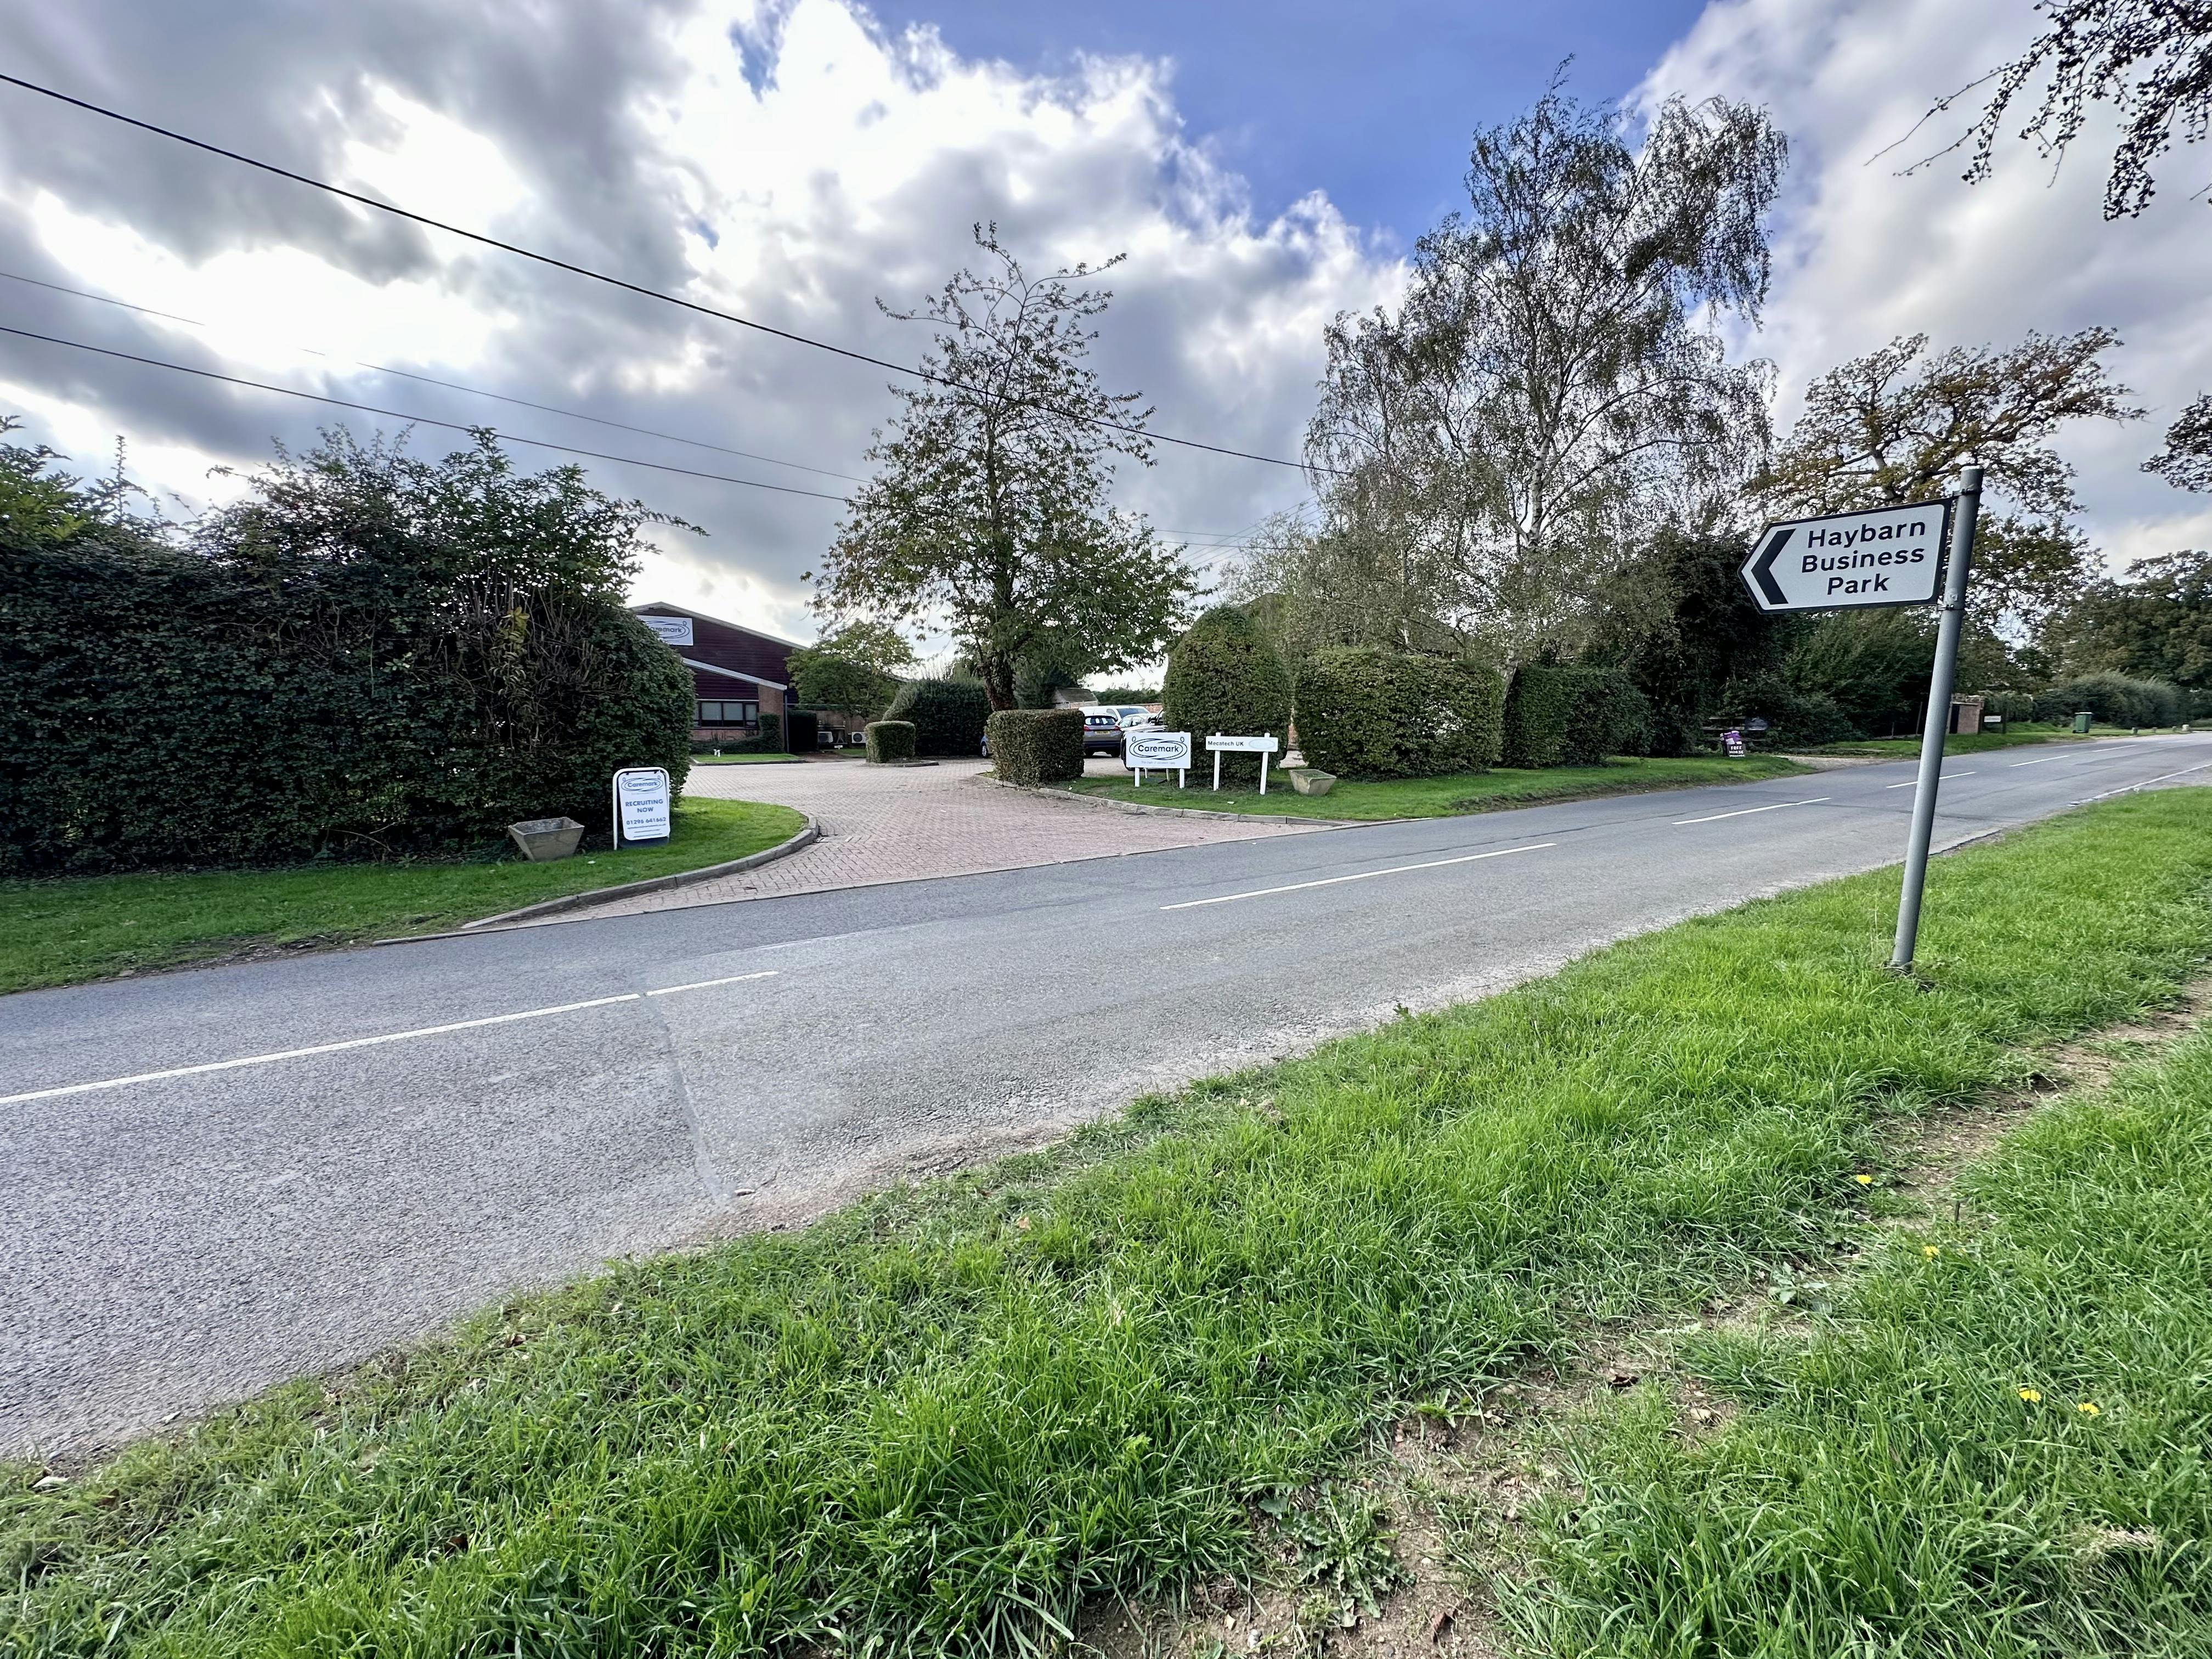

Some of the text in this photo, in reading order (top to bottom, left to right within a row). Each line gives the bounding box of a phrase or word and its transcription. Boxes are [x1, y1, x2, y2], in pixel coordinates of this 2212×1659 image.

[1808, 521, 1925, 548] Haybarn
[1802, 548, 1925, 573] Business
[1827, 573, 1890, 595] Park
